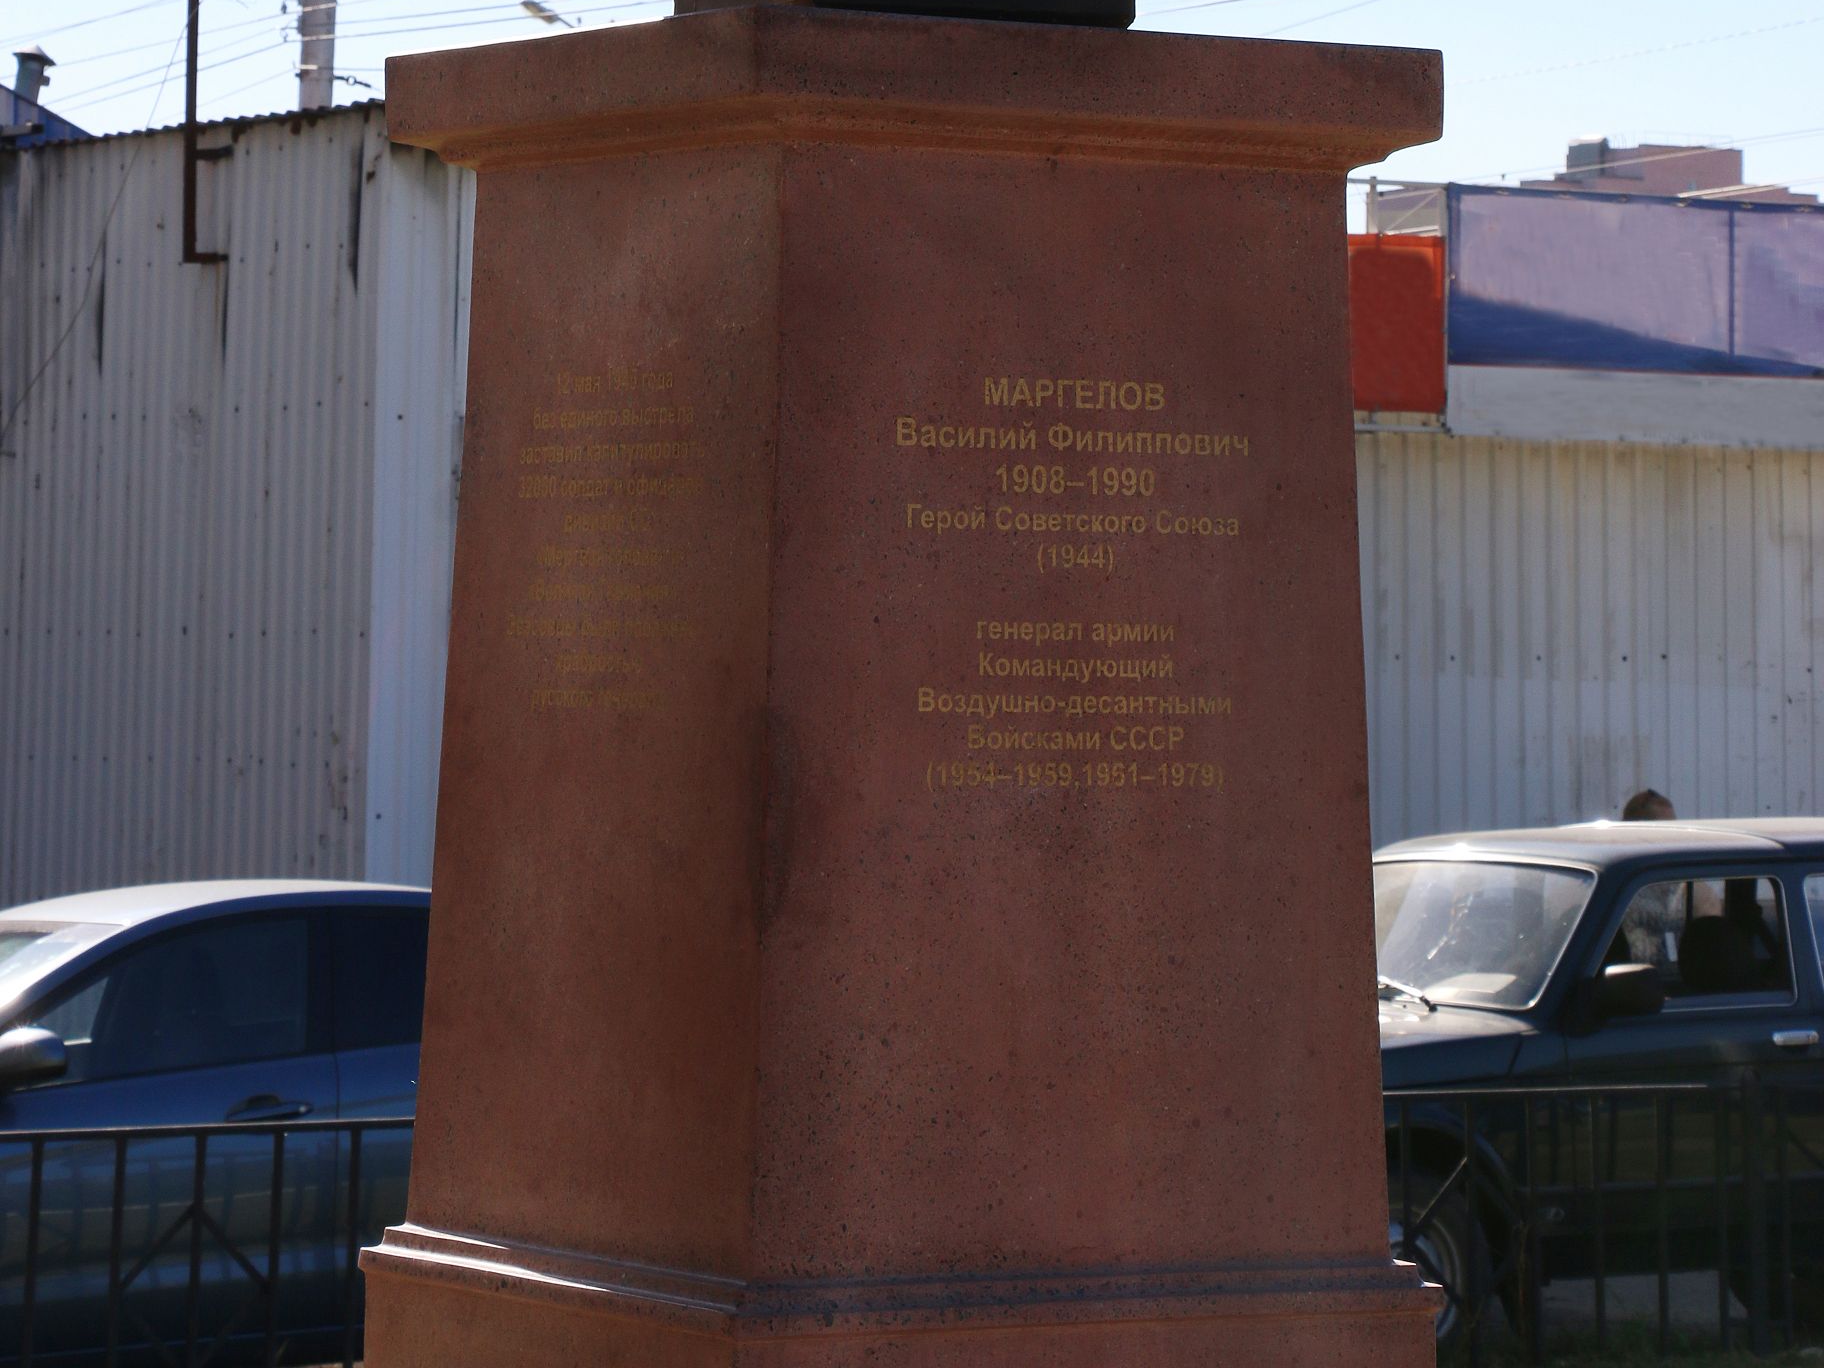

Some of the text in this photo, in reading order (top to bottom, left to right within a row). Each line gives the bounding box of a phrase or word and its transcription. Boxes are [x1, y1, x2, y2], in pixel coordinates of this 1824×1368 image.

[984, 377, 1166, 410] МАРГЕЛОВ
[896, 416, 1249, 456] Василий Филиппович
[906, 503, 1240, 537] Герой Советского Союза
[1038, 544, 1115, 573] (1944)
[976, 619, 1175, 647] генерал армии
[978, 652, 1174, 683] Командующий
[918, 687, 1232, 716] Воздушно-десантными
[968, 725, 1185, 751] Войсками СССР
